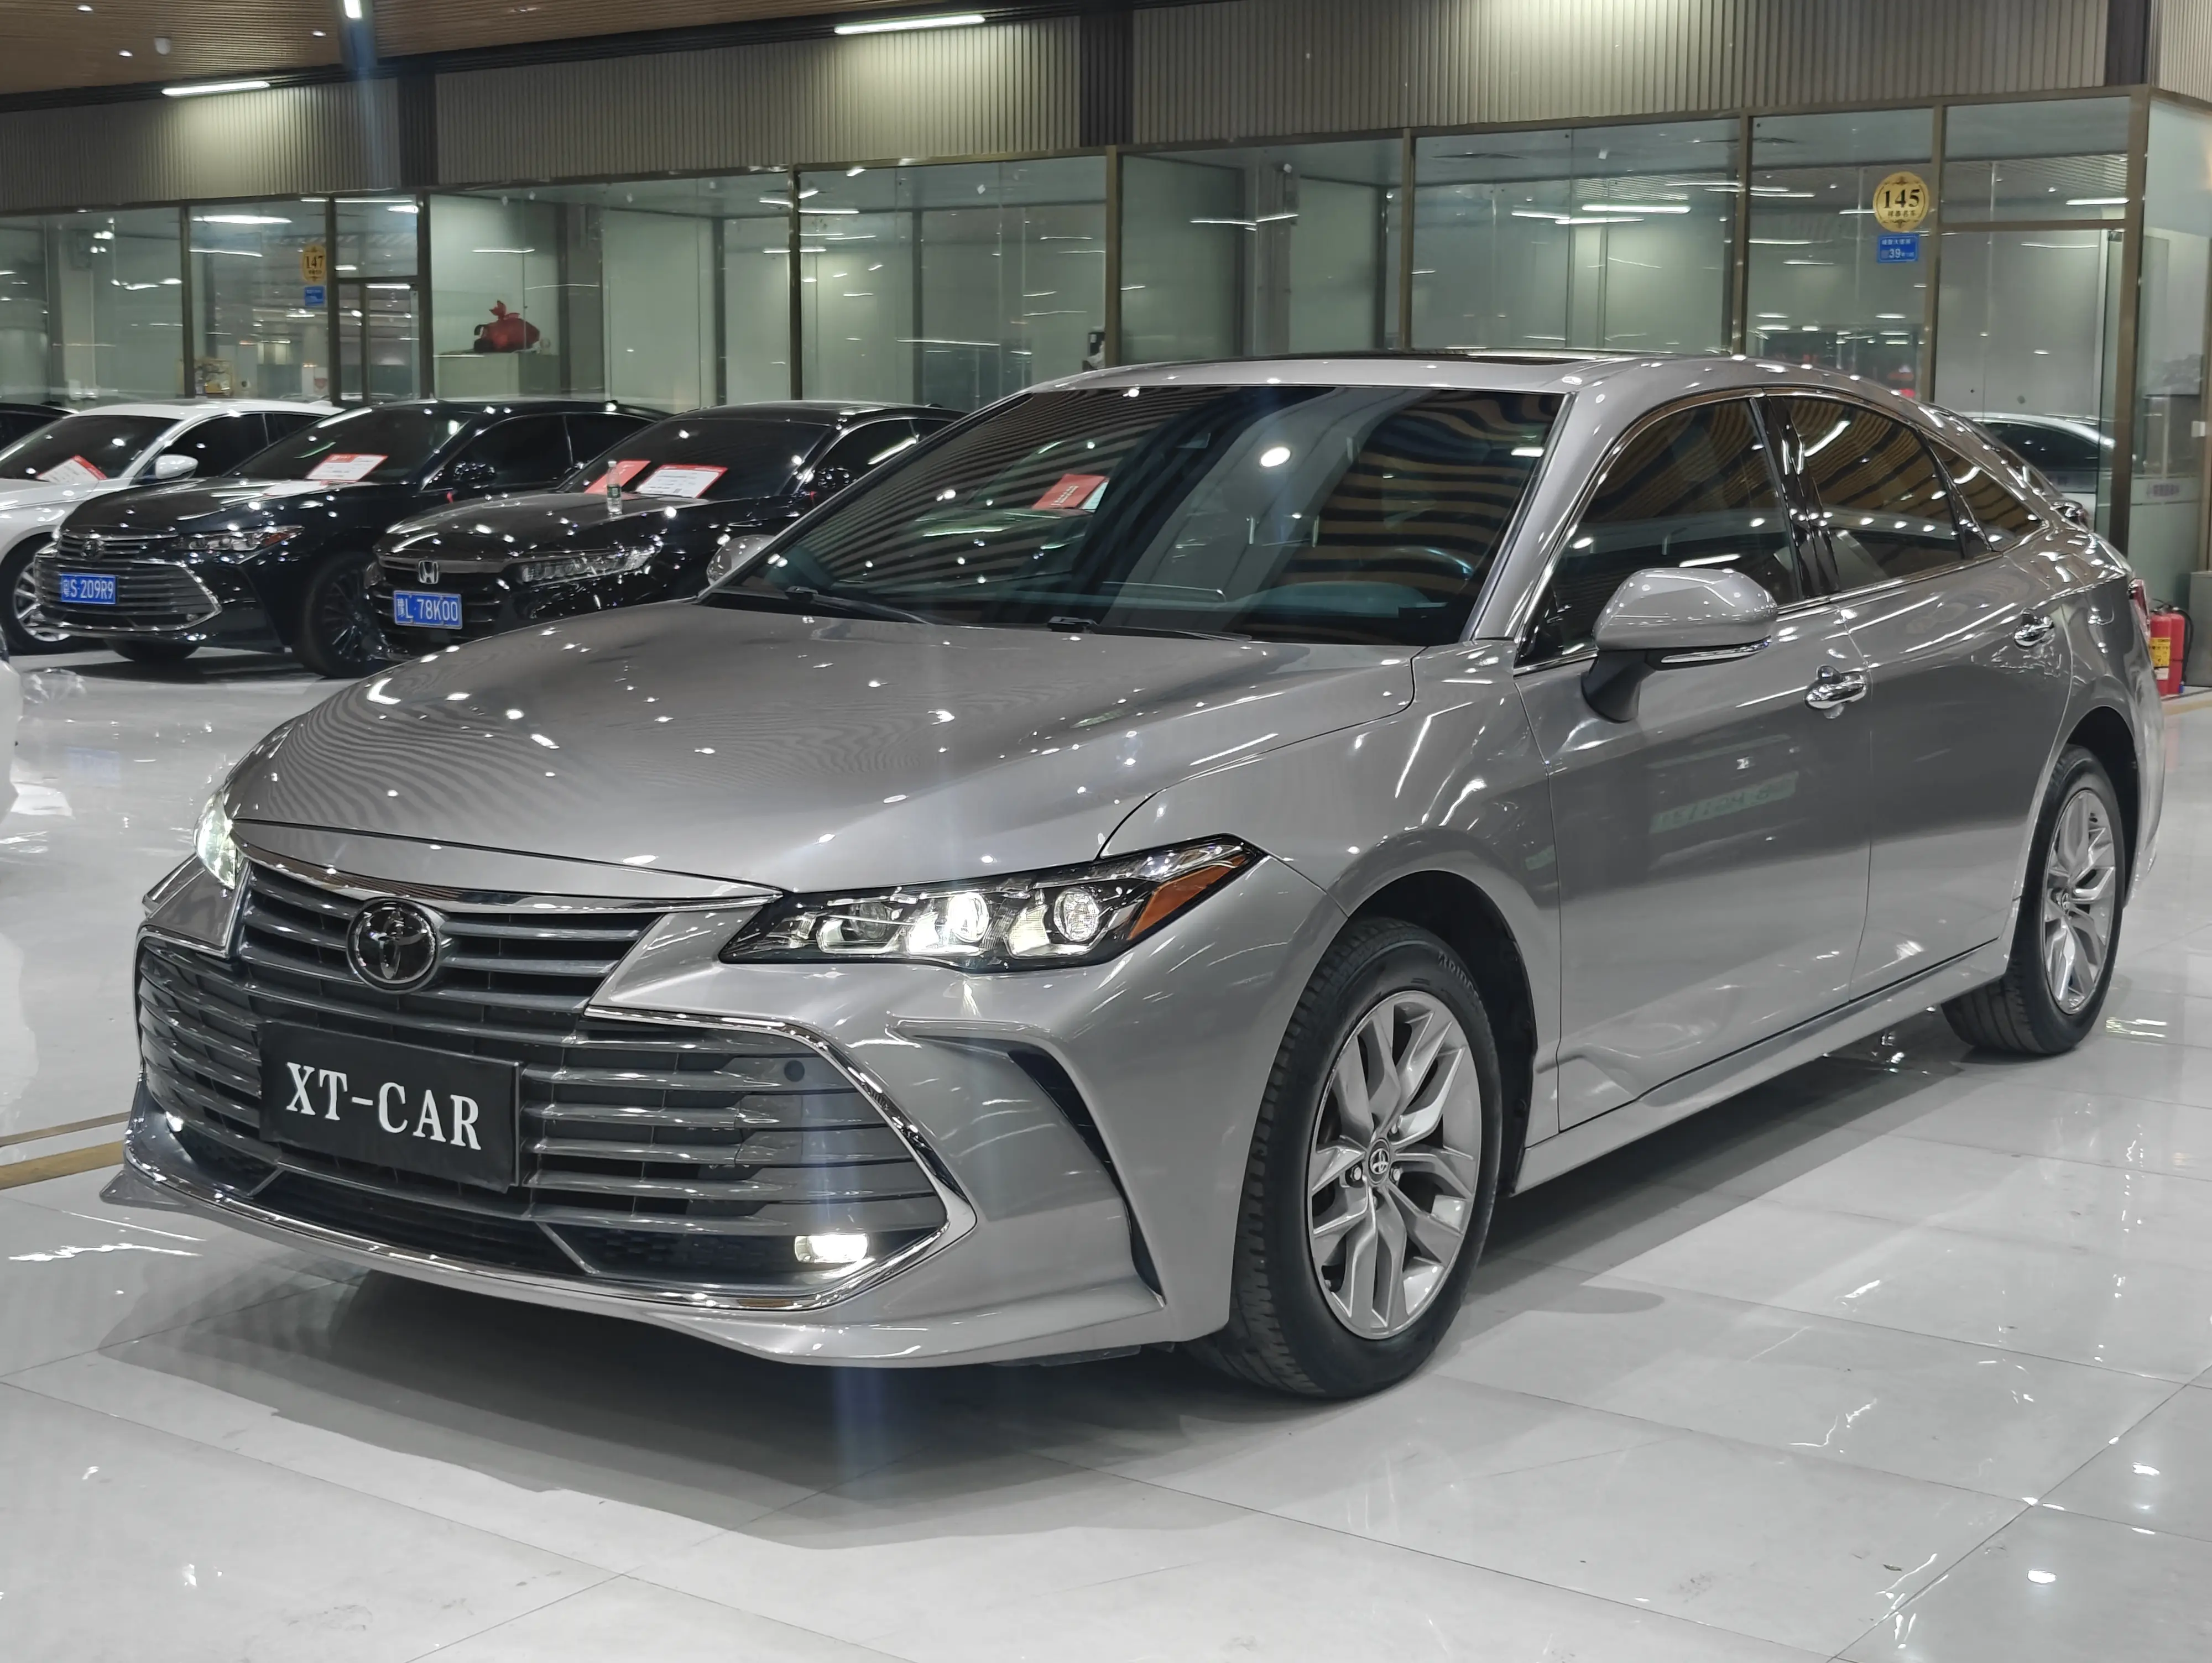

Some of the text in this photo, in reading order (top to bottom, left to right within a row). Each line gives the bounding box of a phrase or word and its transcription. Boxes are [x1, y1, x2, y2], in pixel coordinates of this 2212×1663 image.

[1883, 189, 1920, 209] 145
[306, 255, 324, 269] 147
[286, 1061, 482, 1150] XT-CAR
